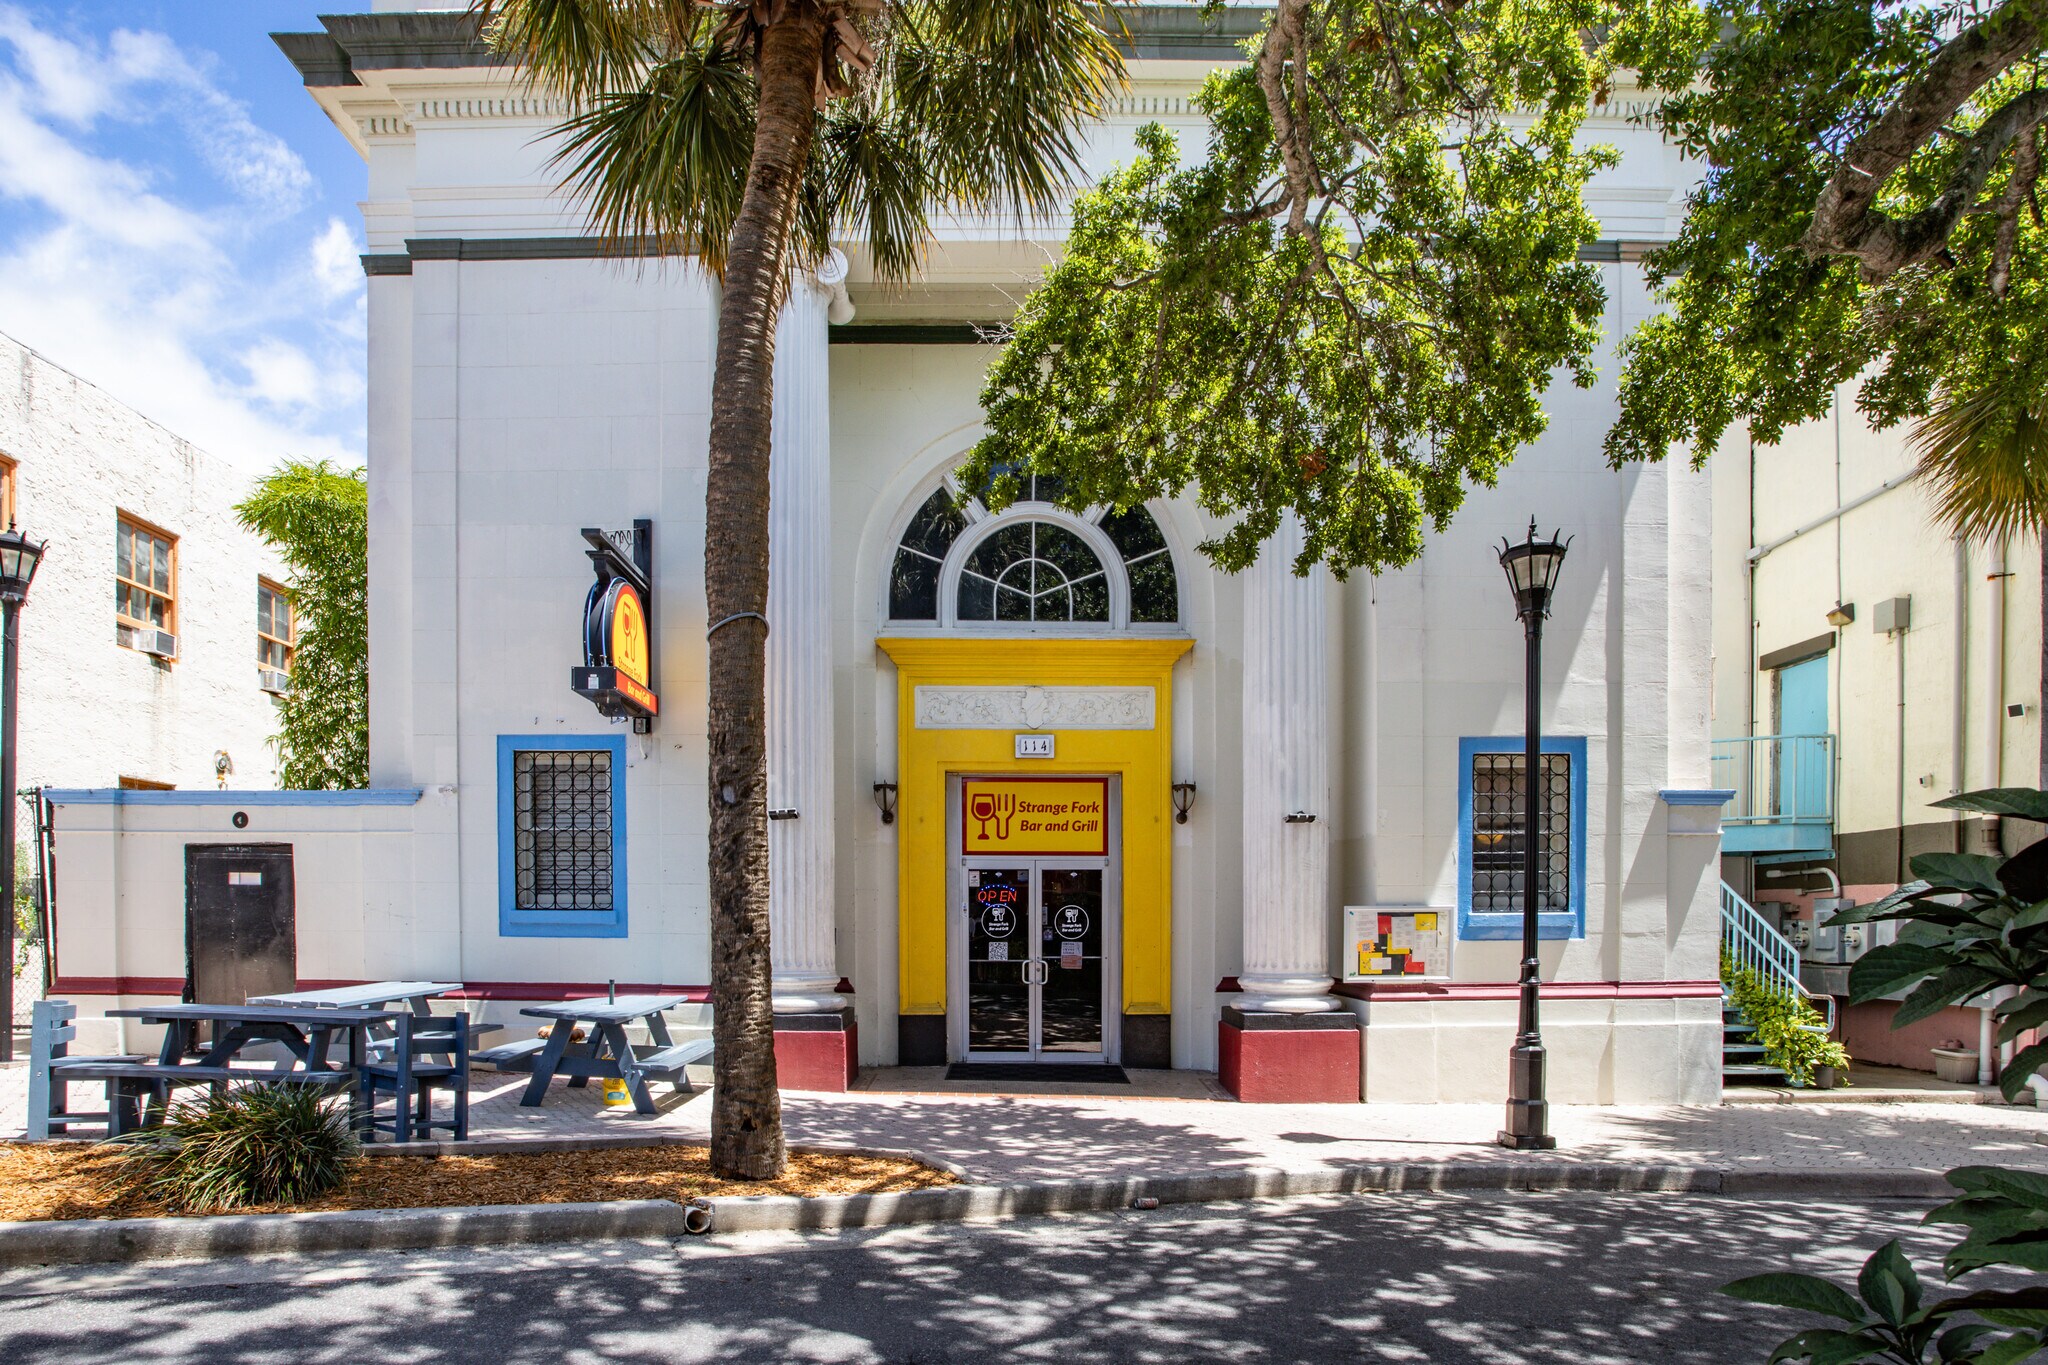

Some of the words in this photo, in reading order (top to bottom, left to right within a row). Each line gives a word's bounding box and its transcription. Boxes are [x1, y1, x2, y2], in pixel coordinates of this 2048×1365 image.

[627, 681, 635, 697] Bar
[642, 690, 650, 706] Grill
[1024, 740, 1047, 752] 114
[1018, 801, 1068, 816] Strange
[1071, 801, 1100, 813] Fork
[1020, 820, 1042, 832] Bar
[1044, 820, 1069, 832] and
[1071, 820, 1098, 832] Grill
[977, 890, 1017, 902] OPEN
